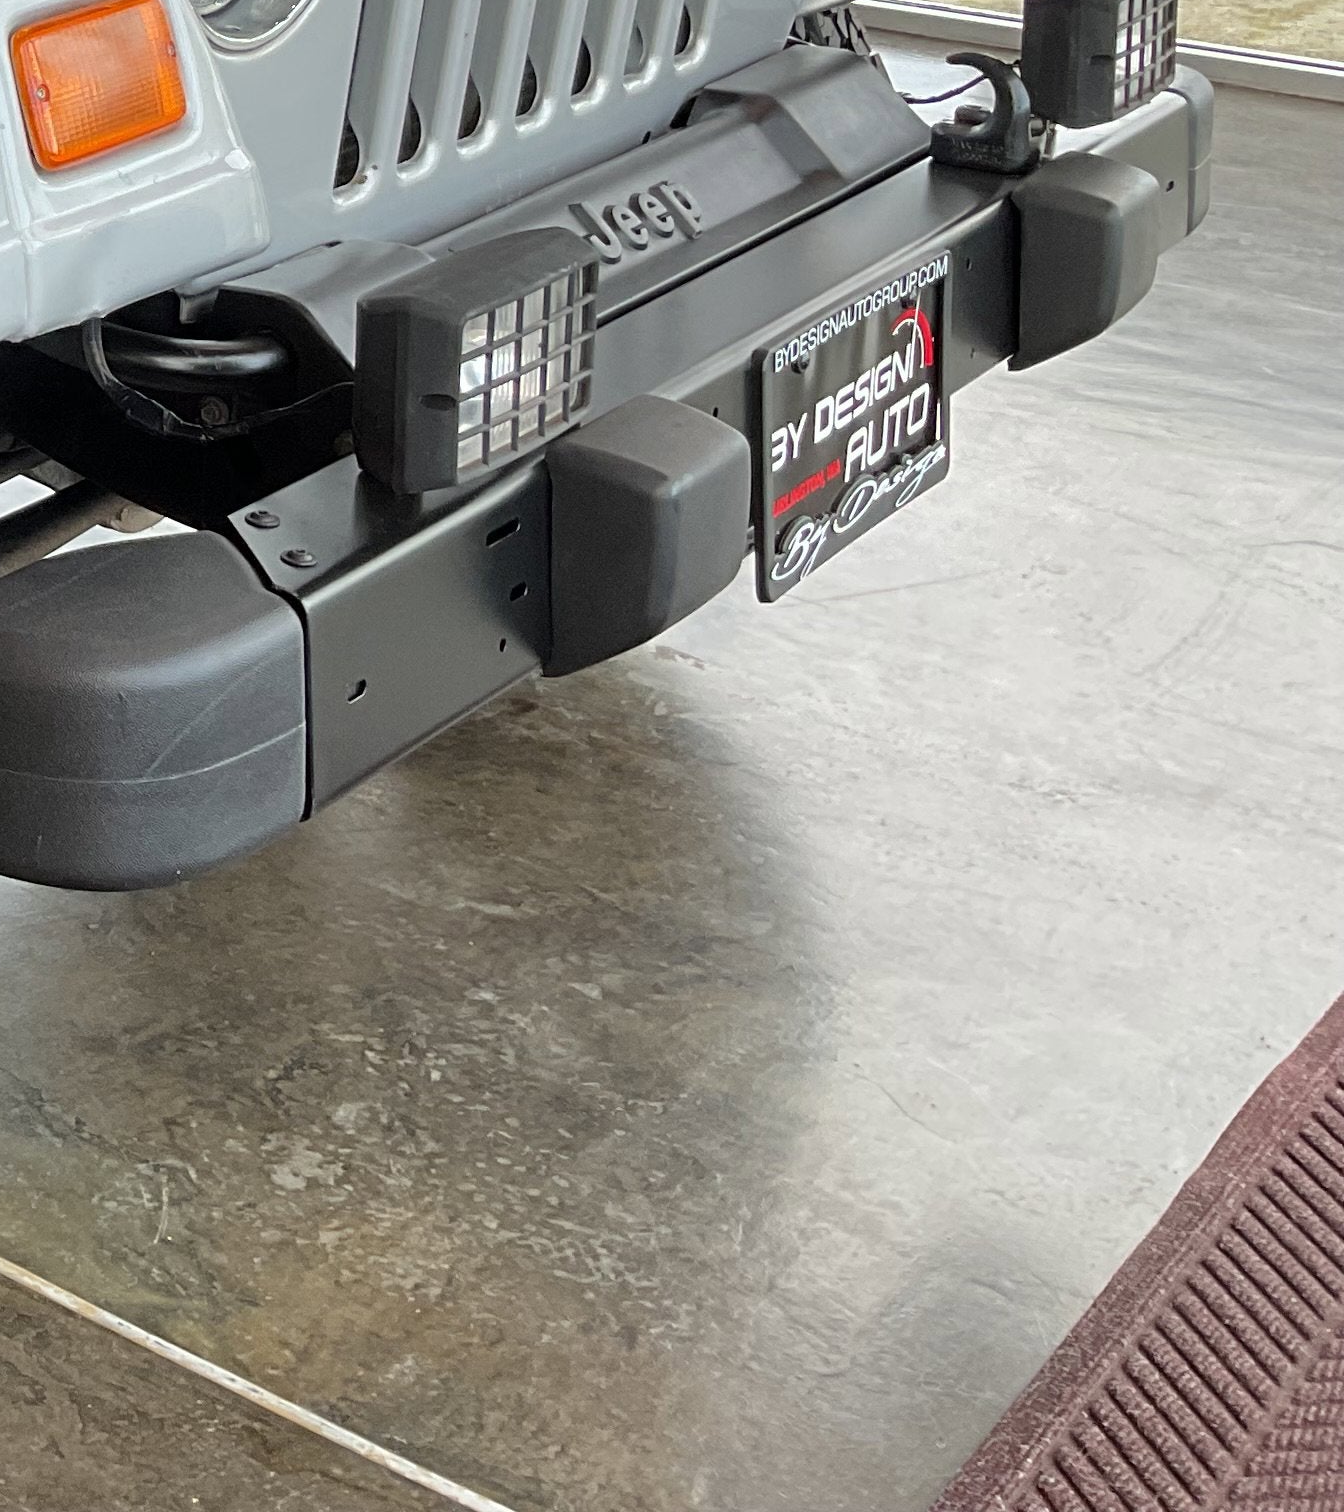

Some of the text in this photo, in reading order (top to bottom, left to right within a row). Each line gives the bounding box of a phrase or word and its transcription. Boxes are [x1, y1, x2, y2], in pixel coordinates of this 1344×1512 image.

[568, 180, 703, 264] Jeep
[813, 343, 914, 444] DESIGN
[844, 382, 930, 483] AUTO
[770, 443, 948, 581] By Design
